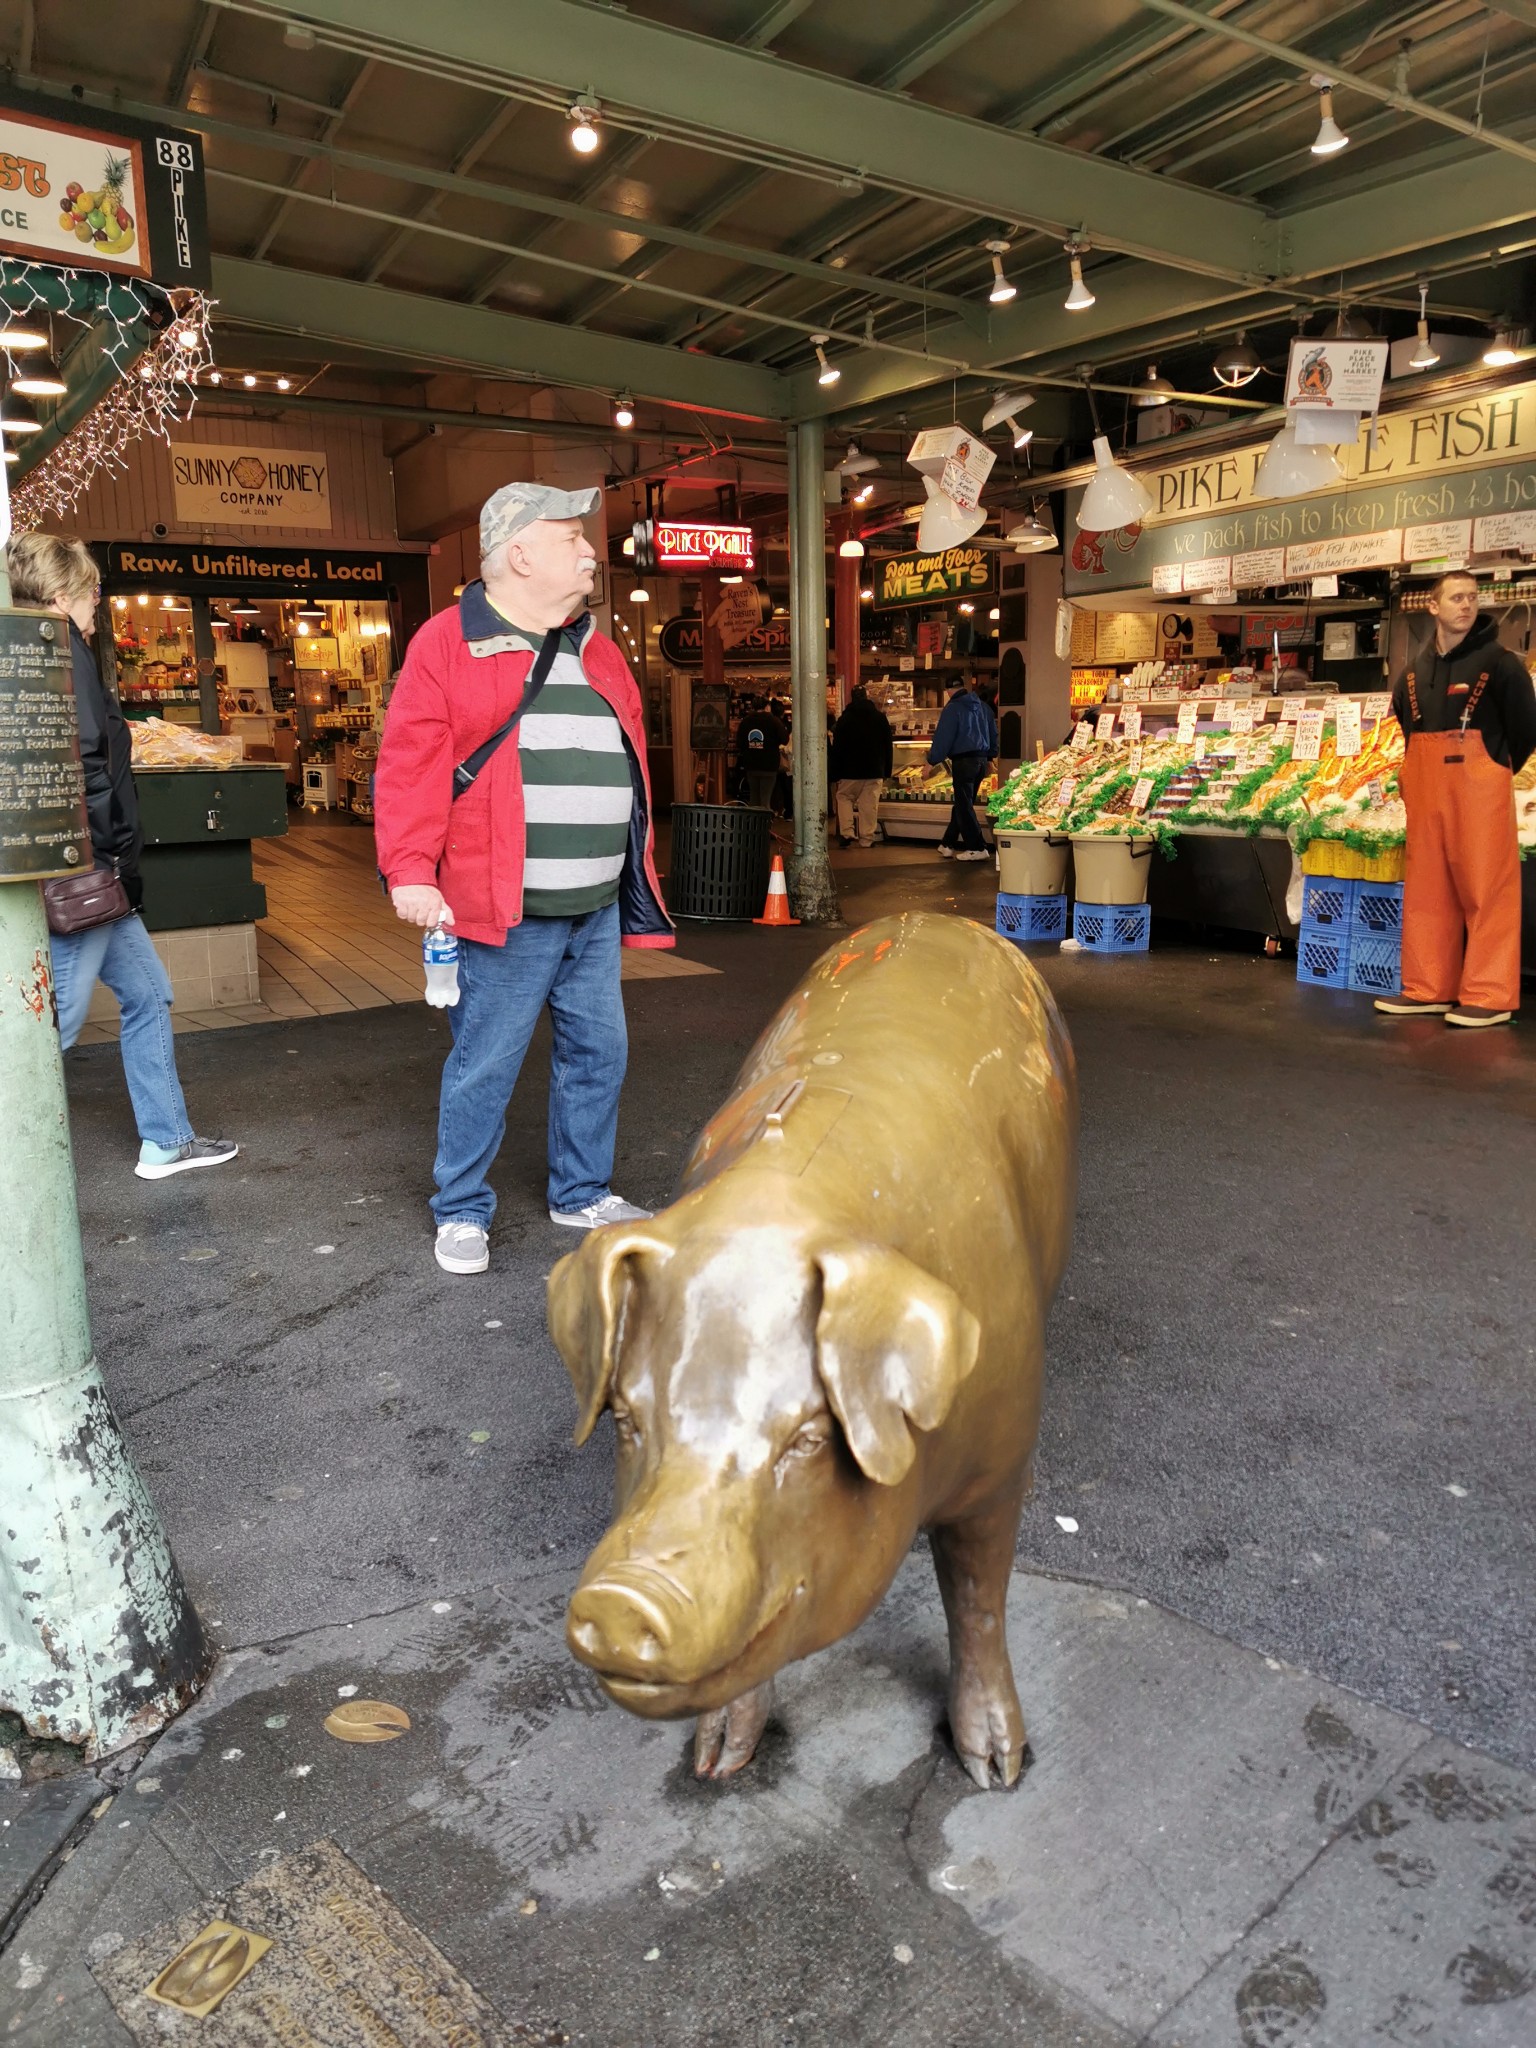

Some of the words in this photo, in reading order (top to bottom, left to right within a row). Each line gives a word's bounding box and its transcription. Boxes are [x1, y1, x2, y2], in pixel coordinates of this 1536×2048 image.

[159, 141, 192, 169] 88
[172, 170, 191, 266] PIKE
[1406, 396, 1523, 467] FISH
[174, 456, 236, 487] SUNNY
[268, 462, 325, 492] HONEY
[1157, 456, 1242, 514] PIKE
[220, 492, 283, 506] COMPANY
[1174, 533, 1195, 554] we
[1203, 519, 1246, 557] pack
[1253, 511, 1292, 547] fish
[1300, 511, 1320, 534] to
[1331, 501, 1384, 533] keep
[1393, 482, 1455, 528] fresh
[658, 529, 701, 554] PLACE
[704, 531, 753, 556] PIGALLE
[1326, 542, 1345, 555] FISH
[120, 552, 184, 574] Raw.
[191, 554, 318, 579] Unfiltered.
[326, 561, 383, 581] Local
[883, 562, 988, 599] MEATS
[885, 560, 915, 578] Don
[916, 551, 945, 573] and
[726, 609, 756, 619] Treasure
[733, 600, 748, 608] Nest
[327, 1894, 401, 1960] MARKET
[304, 1949, 345, 1989] MADE
